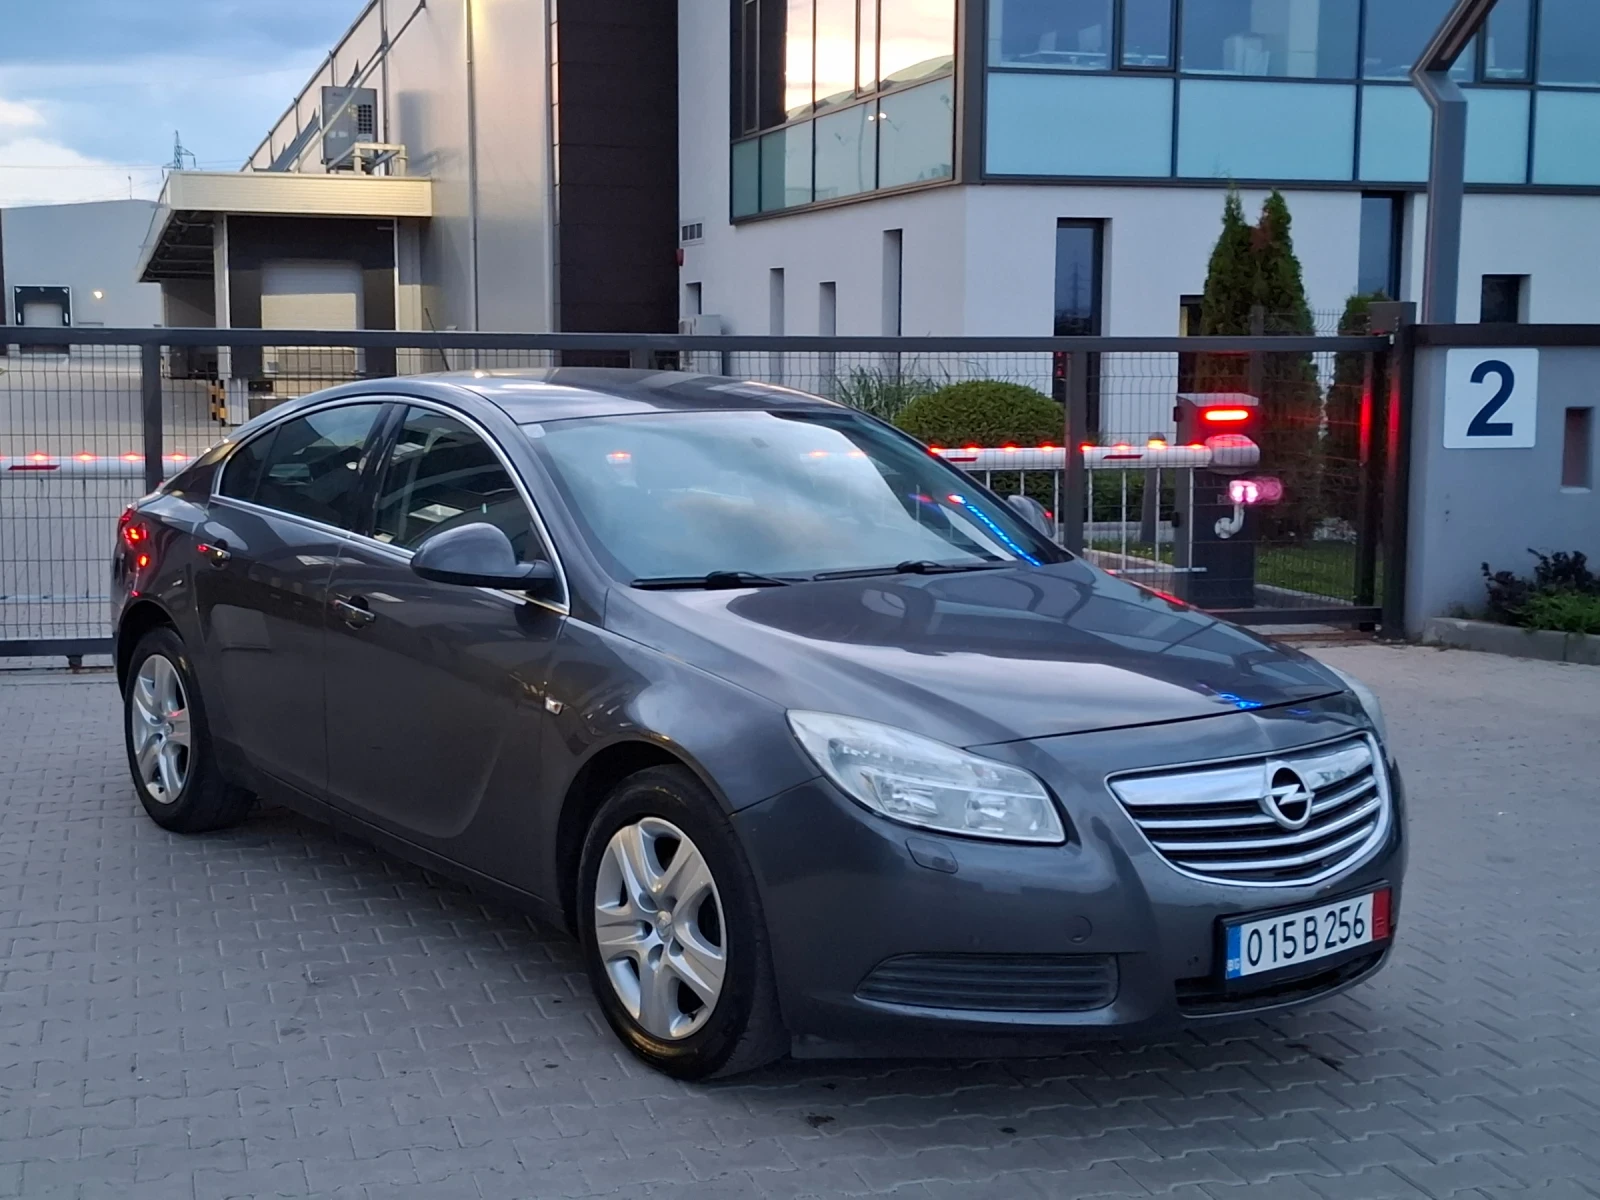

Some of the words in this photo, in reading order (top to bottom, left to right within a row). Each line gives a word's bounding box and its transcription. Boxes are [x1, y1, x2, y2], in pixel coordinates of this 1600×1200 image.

[1466, 359, 1515, 437] 2
[1227, 958, 1240, 971] BG
[1247, 901, 1365, 967] 015B256
